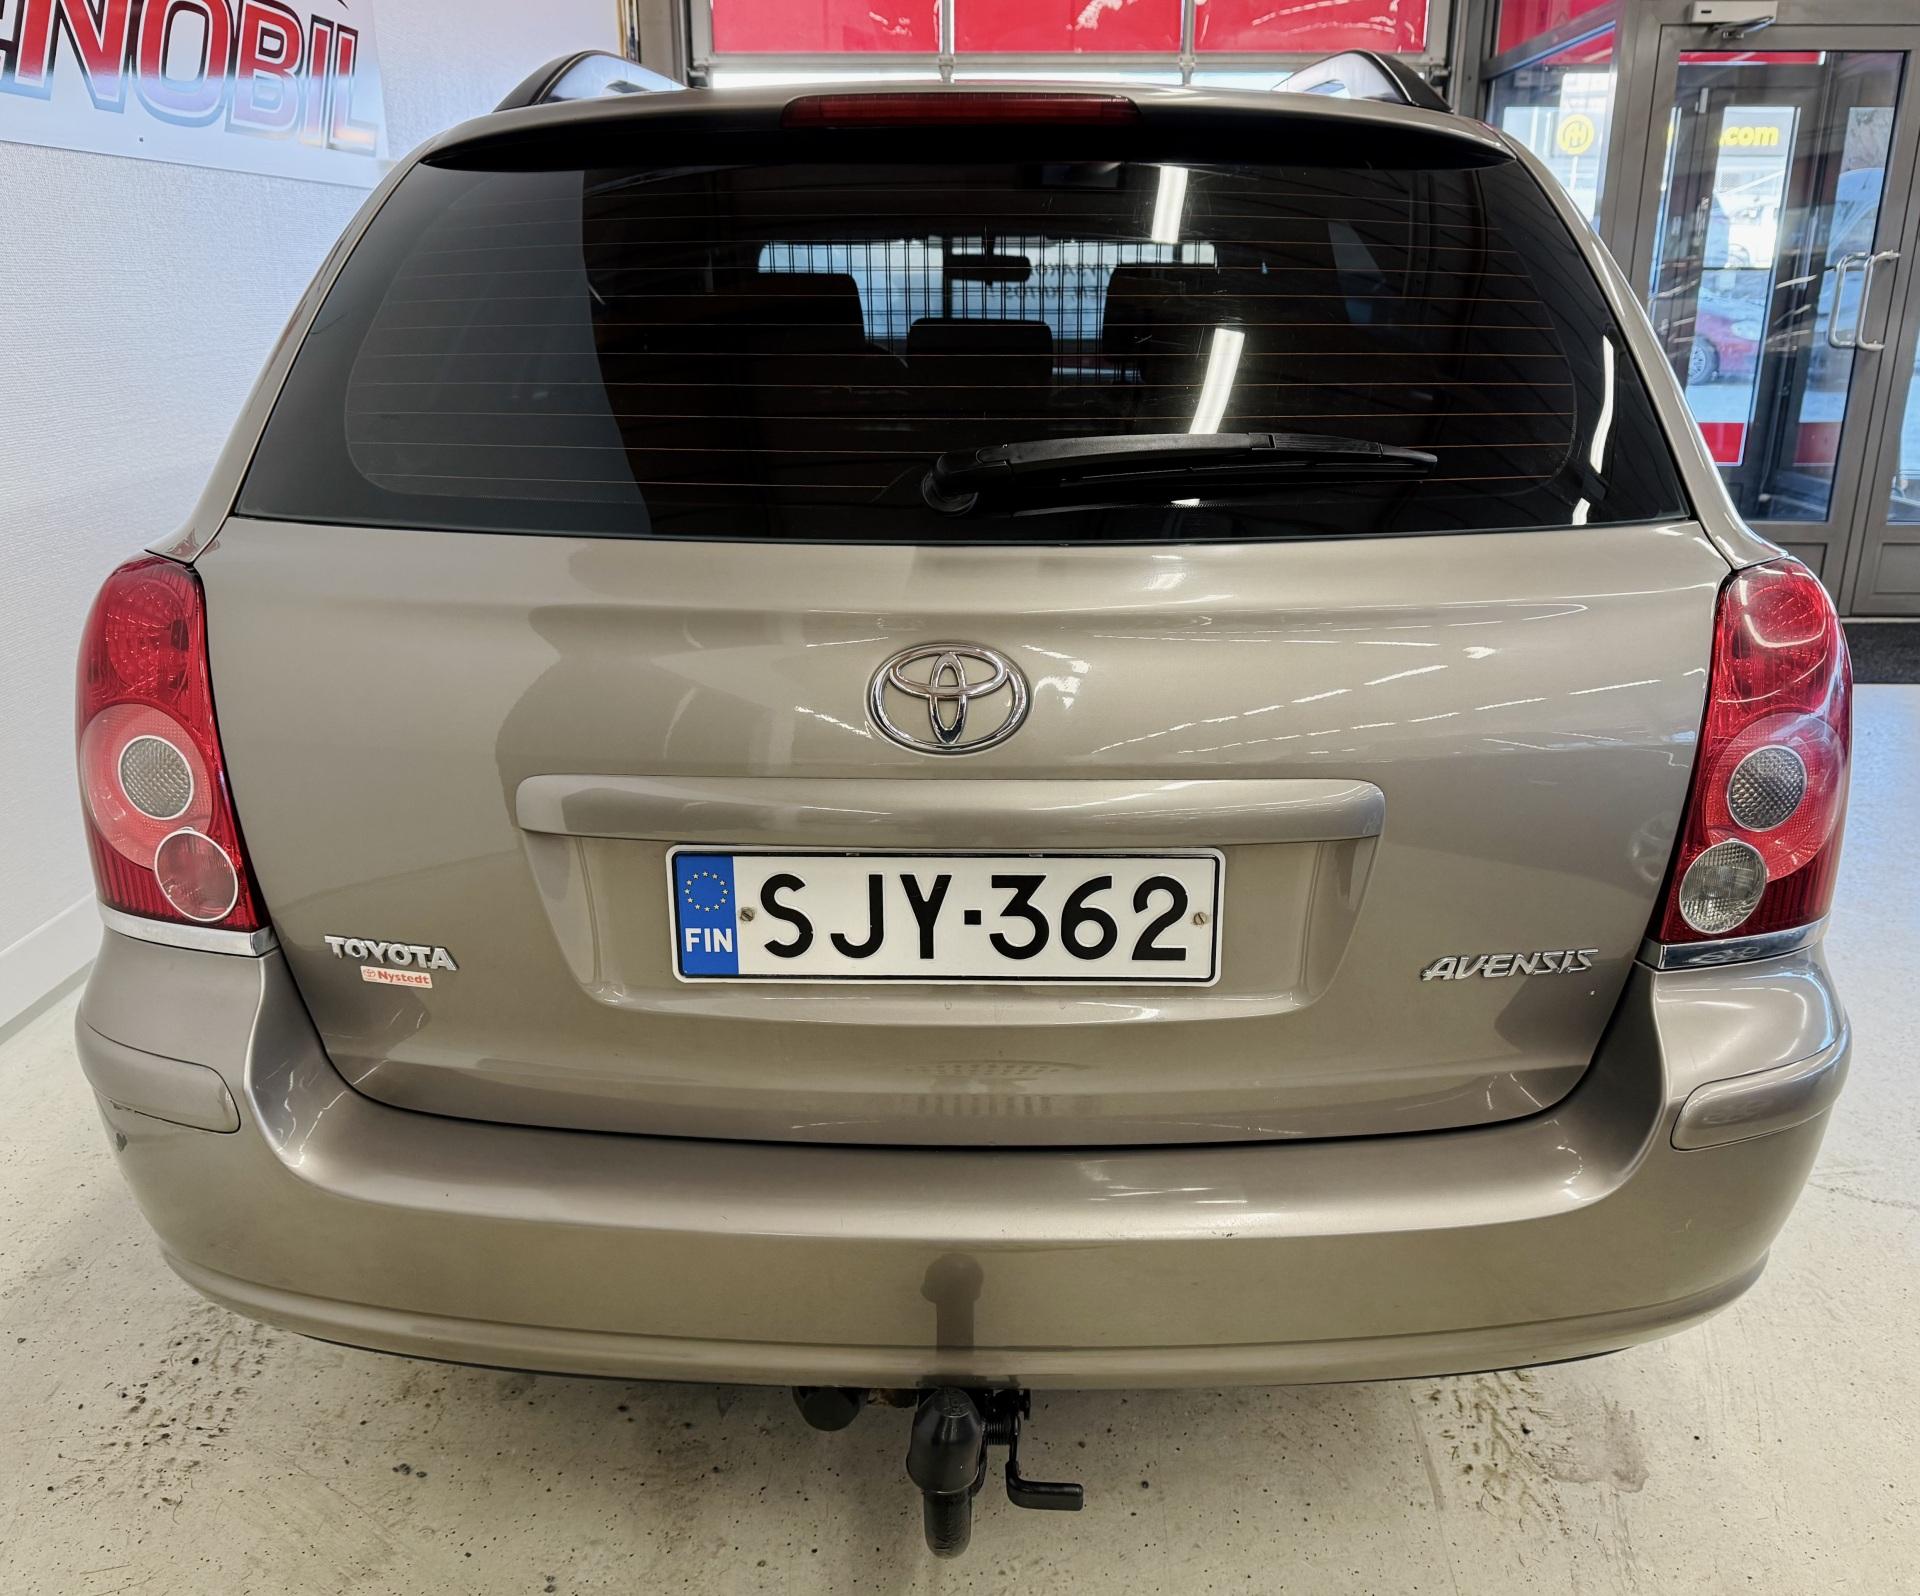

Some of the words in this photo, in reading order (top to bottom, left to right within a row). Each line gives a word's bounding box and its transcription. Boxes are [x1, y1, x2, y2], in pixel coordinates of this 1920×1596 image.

[0, 0, 377, 156] NOBIL
[759, 873, 1190, 961] SJY-362
[324, 935, 458, 970] TOYOTA
[684, 927, 733, 953] FIN
[377, 971, 430, 985] Nystedt
[1420, 948, 1599, 982] AVENSIS
